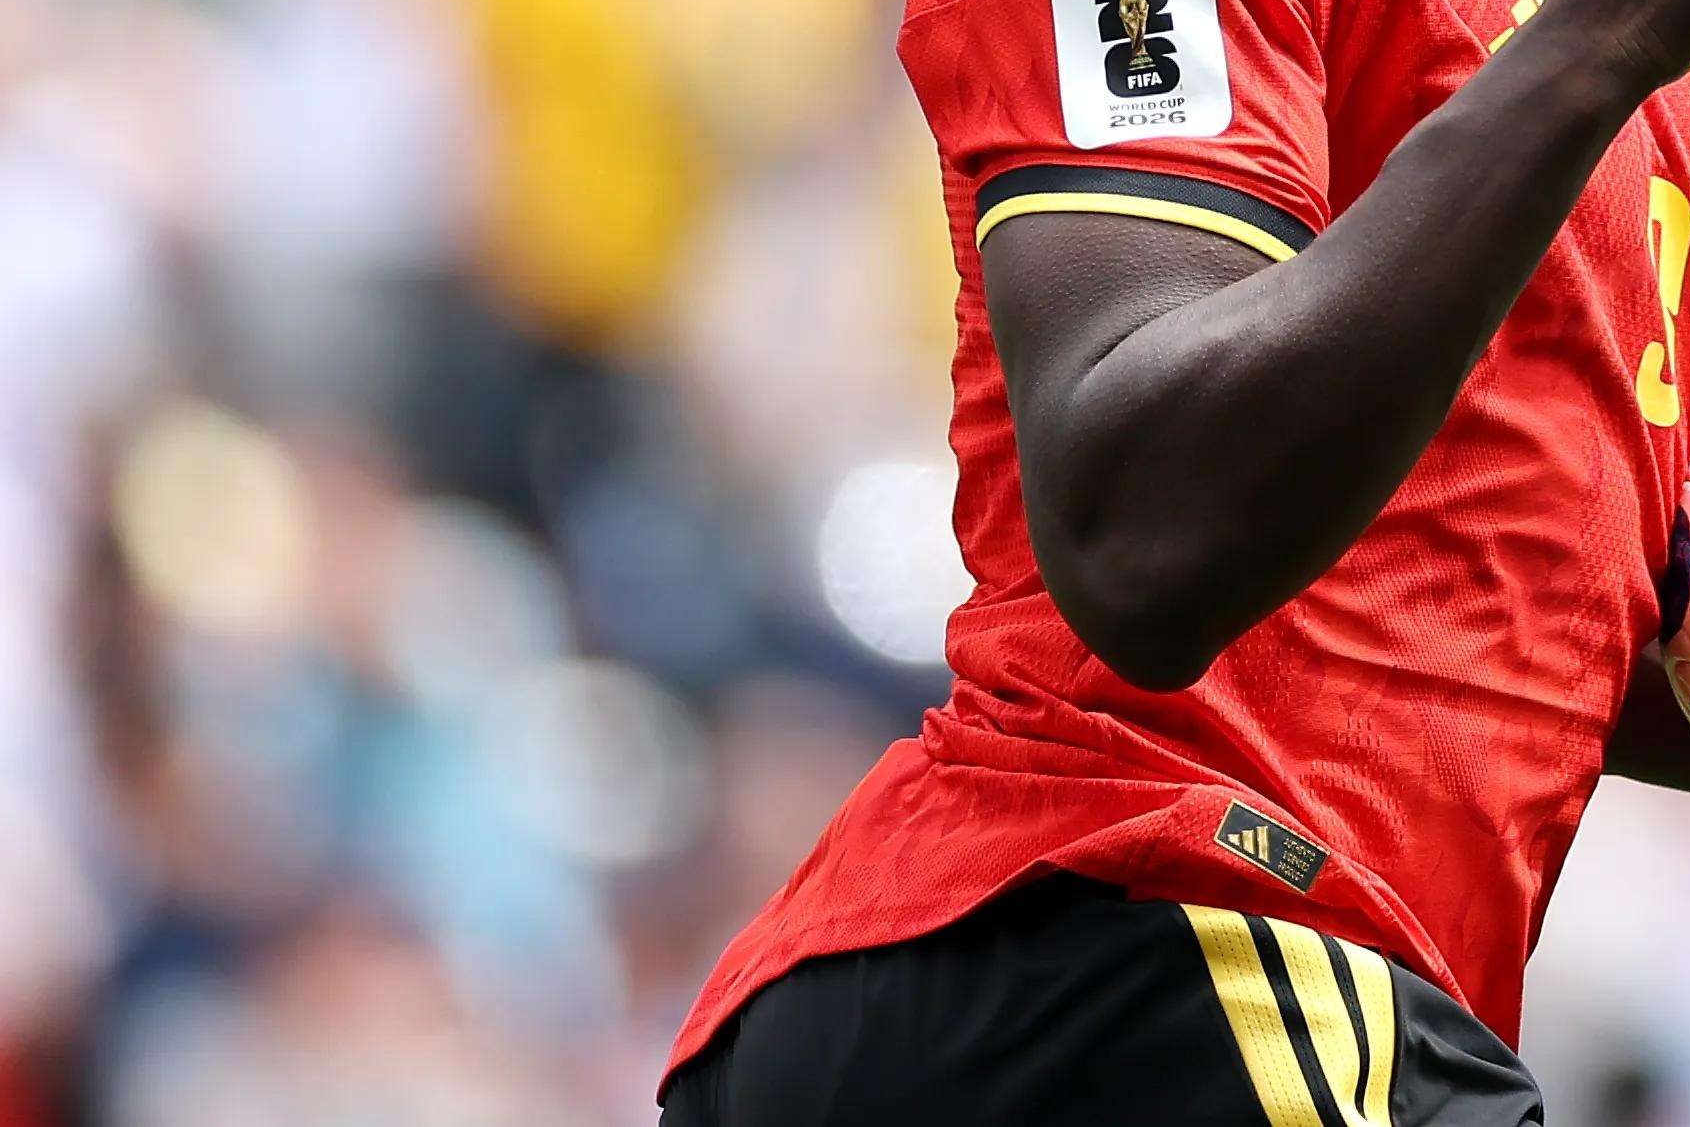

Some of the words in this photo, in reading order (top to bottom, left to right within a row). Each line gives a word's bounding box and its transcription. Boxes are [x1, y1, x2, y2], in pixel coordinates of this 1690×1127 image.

[1127, 72, 1162, 90] FIFA
[1109, 100, 1157, 112] WORLD
[1159, 97, 1185, 108] CUP
[1109, 110, 1186, 128] 2026
